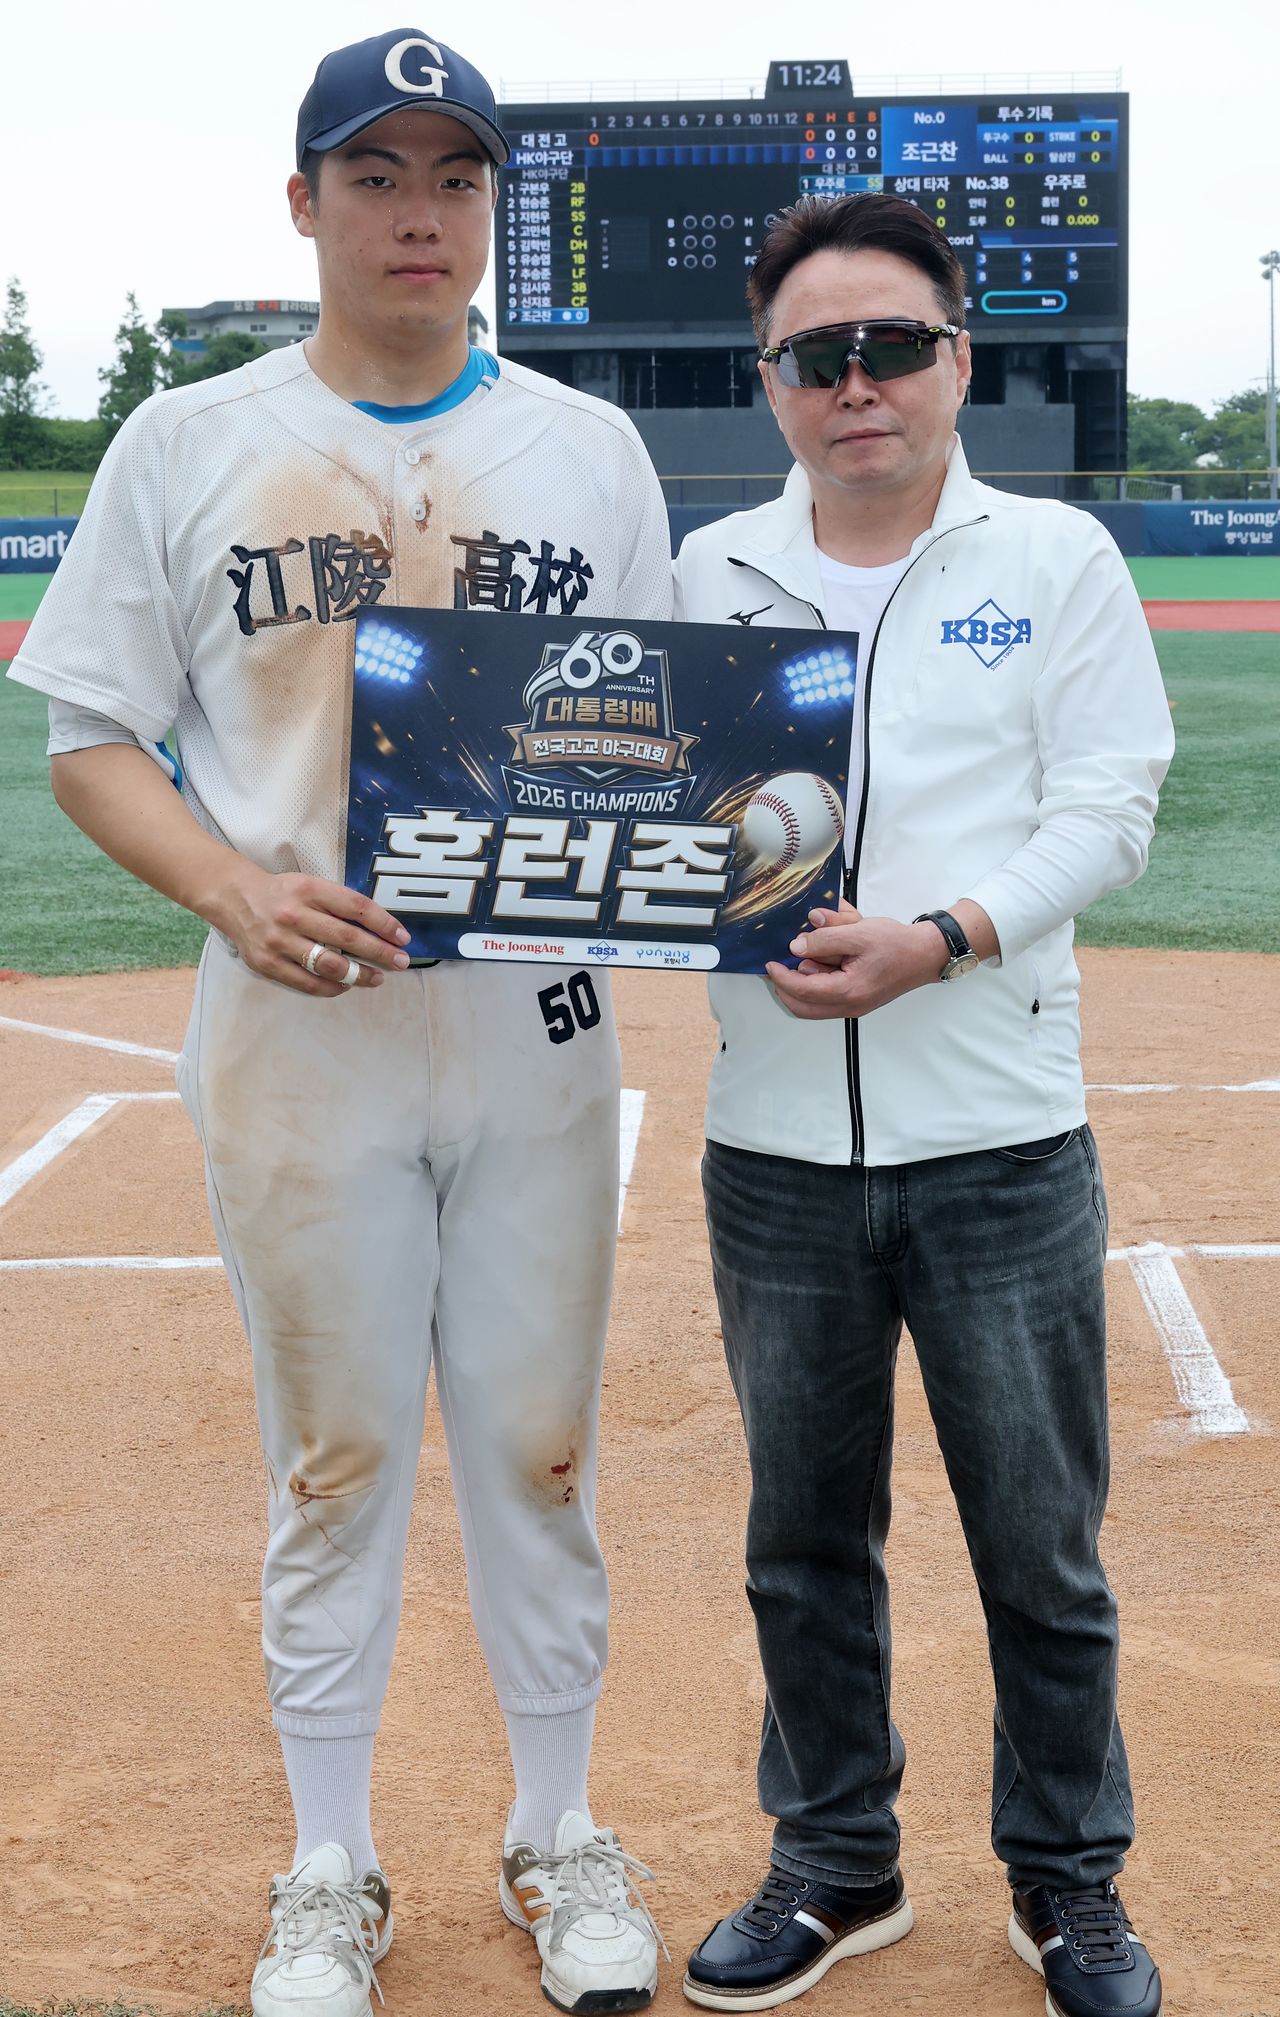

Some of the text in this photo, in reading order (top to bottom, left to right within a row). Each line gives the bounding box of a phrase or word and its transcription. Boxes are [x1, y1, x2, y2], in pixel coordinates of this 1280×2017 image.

[384, 37, 449, 98] G
[778, 65, 842, 86] 11:24
[591, 111, 877, 128] 1 2 3 4 5 6 7 8 9 10 11 12 R H E B
[914, 112, 945, 124] No.0
[998, 106, 1053, 121] 투수 기록
[589, 135, 599, 146] 0
[805, 130, 815, 141] 0
[826, 130, 836, 141] 0
[846, 129, 856, 141] 0
[867, 129, 877, 141] 0
[1024, 132, 1034, 144] 0
[1091, 130, 1101, 142] 0
[516, 147, 877, 165] HK야구단 0 0 0 0
[901, 141, 958, 162] 조근찬
[1091, 151, 1101, 163] 0
[984, 152, 1034, 164] BALL 0
[522, 168, 568, 180] HK야구단
[802, 178, 808, 189] 1
[894, 177, 950, 192] 상대 타자
[966, 177, 1009, 190] No.38
[1044, 175, 1086, 190] 우주로
[508, 184, 514, 195] 1
[570, 183, 586, 194] 2B
[507, 198, 515, 209] 2
[570, 197, 585, 208] RF
[936, 198, 946, 209] 0
[1006, 197, 1015, 208] 0
[1078, 196, 1088, 207] 0
[508, 212, 515, 223] 3
[570, 211, 586, 223] SS
[744, 218, 753, 227] H
[936, 216, 946, 228] 0
[1006, 215, 1015, 227] 0
[1066, 214, 1099, 225] 0.000
[668, 219, 674, 228] B
[508, 227, 516, 237] 4
[574, 225, 583, 236] C
[508, 241, 516, 252] 5
[570, 240, 588, 250] DH
[668, 238, 675, 248] S
[745, 237, 752, 246] E
[948, 234, 974, 246] cord
[508, 255, 516, 266] 6
[574, 254, 586, 265] 1B
[979, 252, 1077, 264] 3 4 5
[509, 269, 516, 280] 7
[572, 268, 586, 279] LF
[979, 270, 1078, 282] 8 9 10
[508, 283, 516, 294] 8
[572, 282, 587, 293] 3B
[509, 297, 517, 308] 9
[571, 296, 587, 307] CF
[1042, 297, 1056, 306] km
[509, 311, 517, 321] P
[576, 310, 583, 321] 0
[1190, 510, 1224, 526] The
[227, 529, 593, 635] 江陵 高校
[941, 618, 1031, 646] KBSA
[559, 633, 643, 689] 60
[637, 675, 655, 686] TH
[605, 684, 655, 695] ANNIVERSARY
[545, 697, 658, 729] 대통령배
[532, 738, 668, 764] 전국고교 야구대회
[513, 780, 682, 812] 2026 CHAMPIONS
[371, 807, 736, 927] 홈런존
[482, 939, 564, 955] The JoongAng
[587, 946, 619, 956] KBSA
[537, 969, 601, 1045] 50
